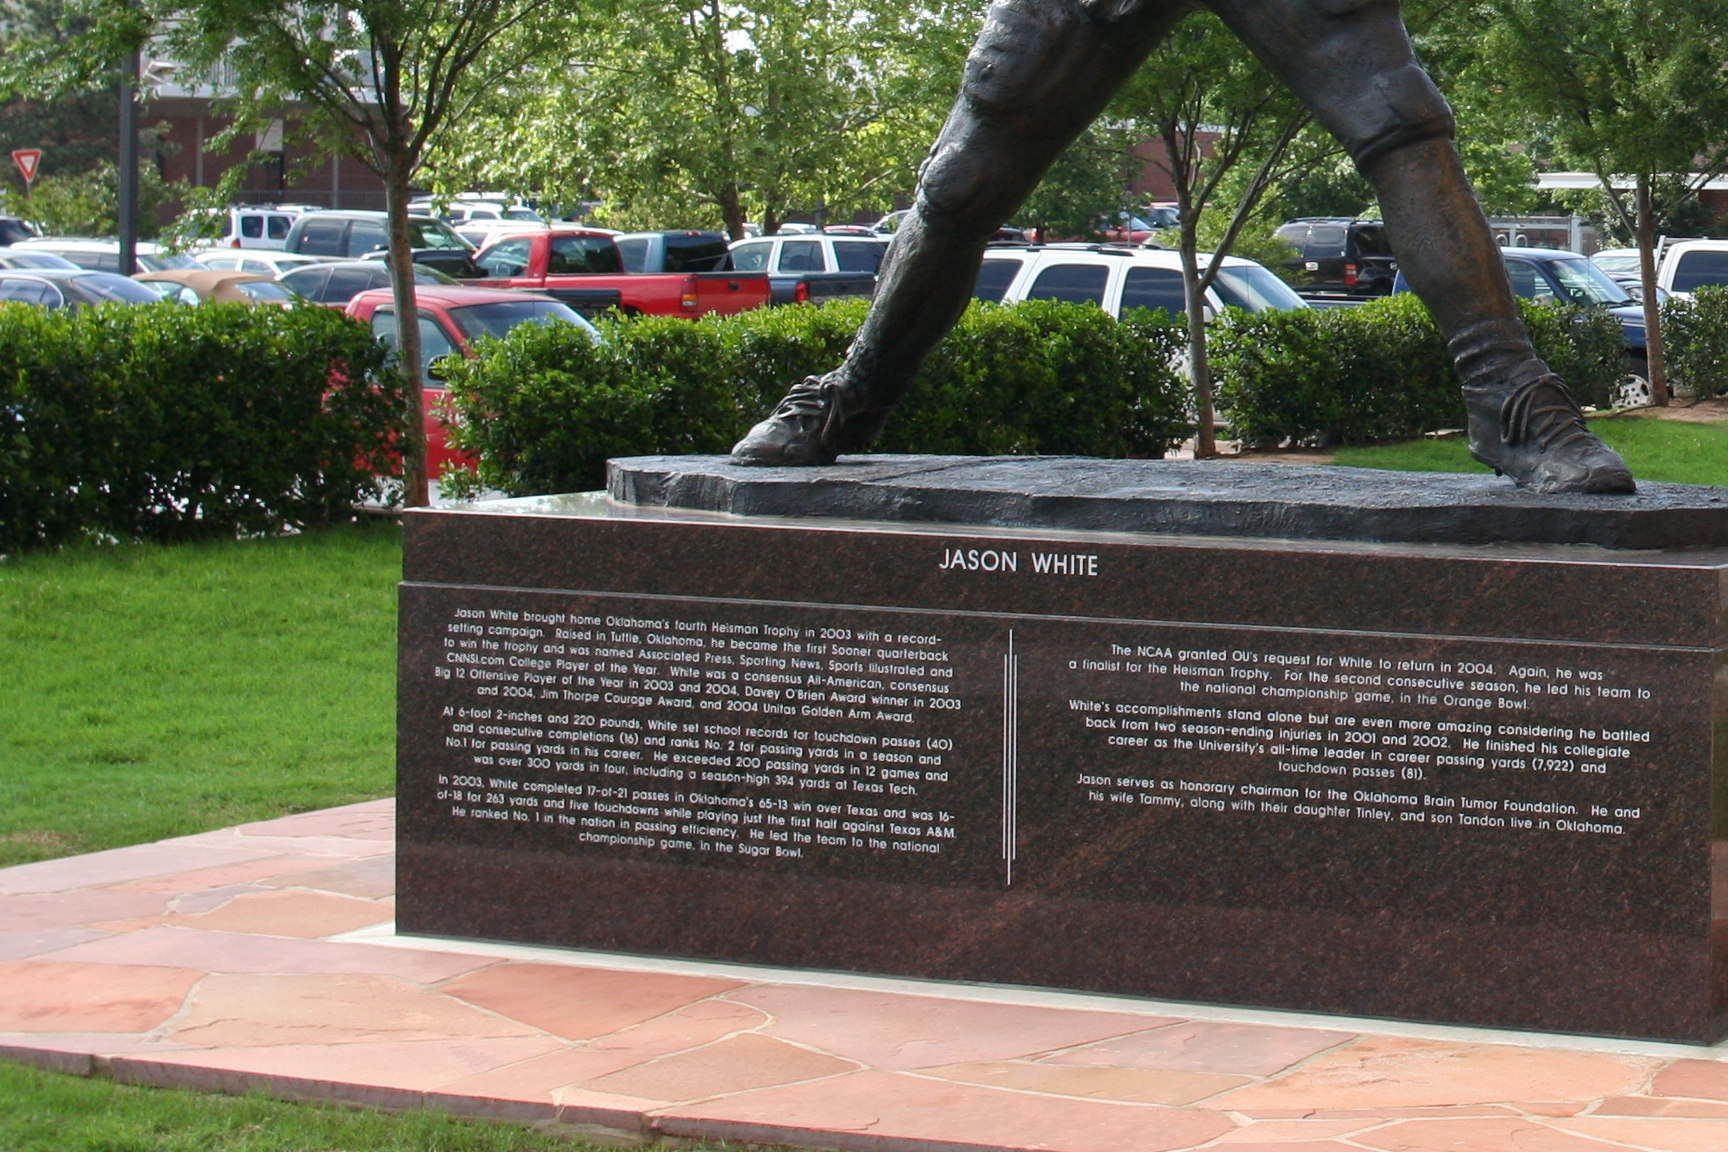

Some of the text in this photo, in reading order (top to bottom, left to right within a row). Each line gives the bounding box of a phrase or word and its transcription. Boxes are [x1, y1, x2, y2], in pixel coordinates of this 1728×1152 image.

[939, 548, 1098, 576] JASON WHITE
[454, 608, 485, 619] Jason
[490, 610, 518, 621] White
[523, 612, 565, 625] brought
[570, 614, 600, 626] home
[606, 616, 669, 629] Oklahoma's
[675, 620, 706, 631] fourth
[711, 622, 758, 634] Heisman
[764, 625, 799, 639] Trophy
[805, 627, 814, 637] in
[820, 628, 851, 639] 2003
[856, 630, 879, 641] with
[897, 634, 941, 644] record-
[1068, 660, 1650, 698] a finalist for the Heisman Trophy. For the second consecutive season, he led his team to
[1112, 645, 1131, 656] The
[1137, 646, 1172, 658] NCAA
[1178, 650, 1226, 661] granted
[1232, 651, 1258, 663] OU's
[1264, 655, 1310, 666] request
[1316, 655, 1332, 666] for
[1339, 656, 1372, 668] White
[1379, 659, 1391, 669] to
[1397, 660, 1434, 672] return
[1440, 662, 1451, 672] in
[1458, 663, 1495, 675] 2004.
[1556, 668, 1572, 679] he
[1578, 671, 1602, 680] was
[477, 686, 498, 696] and
[540, 689, 558, 700] Jim
[563, 691, 599, 705] Thorpe
[604, 693, 652, 708] Courage
[699, 700, 721, 710] and
[726, 701, 758, 713] 2004
[763, 703, 796, 715] Unitas
[801, 706, 842, 718] Golden
[848, 709, 870, 720] Arm
[876, 710, 914, 722] Award.
[1069, 699, 1649, 742] White's accomplishments stand alone but are even more amazing considering he battled
[1086, 717, 1630, 759] back from two season-ending injuries in 2001 and 2002. He finished his collegiate
[1108, 737, 1606, 773] career as the University's all-time leader in career passing yards (7,922) and
[473, 757, 493, 765] was
[498, 758, 521, 767] over
[527, 758, 550, 769] 300
[555, 761, 584, 772] yards
[589, 762, 599, 773] in
[633, 765, 683, 781] including
[701, 772, 769, 787] season-high
[775, 775, 793, 786] 394
[799, 778, 829, 789] yards
[835, 780, 847, 790] at
[853, 781, 883, 792] Texas
[889, 783, 918, 795] Tech.
[1278, 761, 1425, 780] touchdown passes (81).
[1076, 774, 1640, 818] Jason serves as honorary chairman for the Oklahoma Brain Tumor Foundation. He and
[1088, 789, 1625, 834] his wife Tammy, along with their daughter Tinley, and son Tandon live in Oklahoma.
